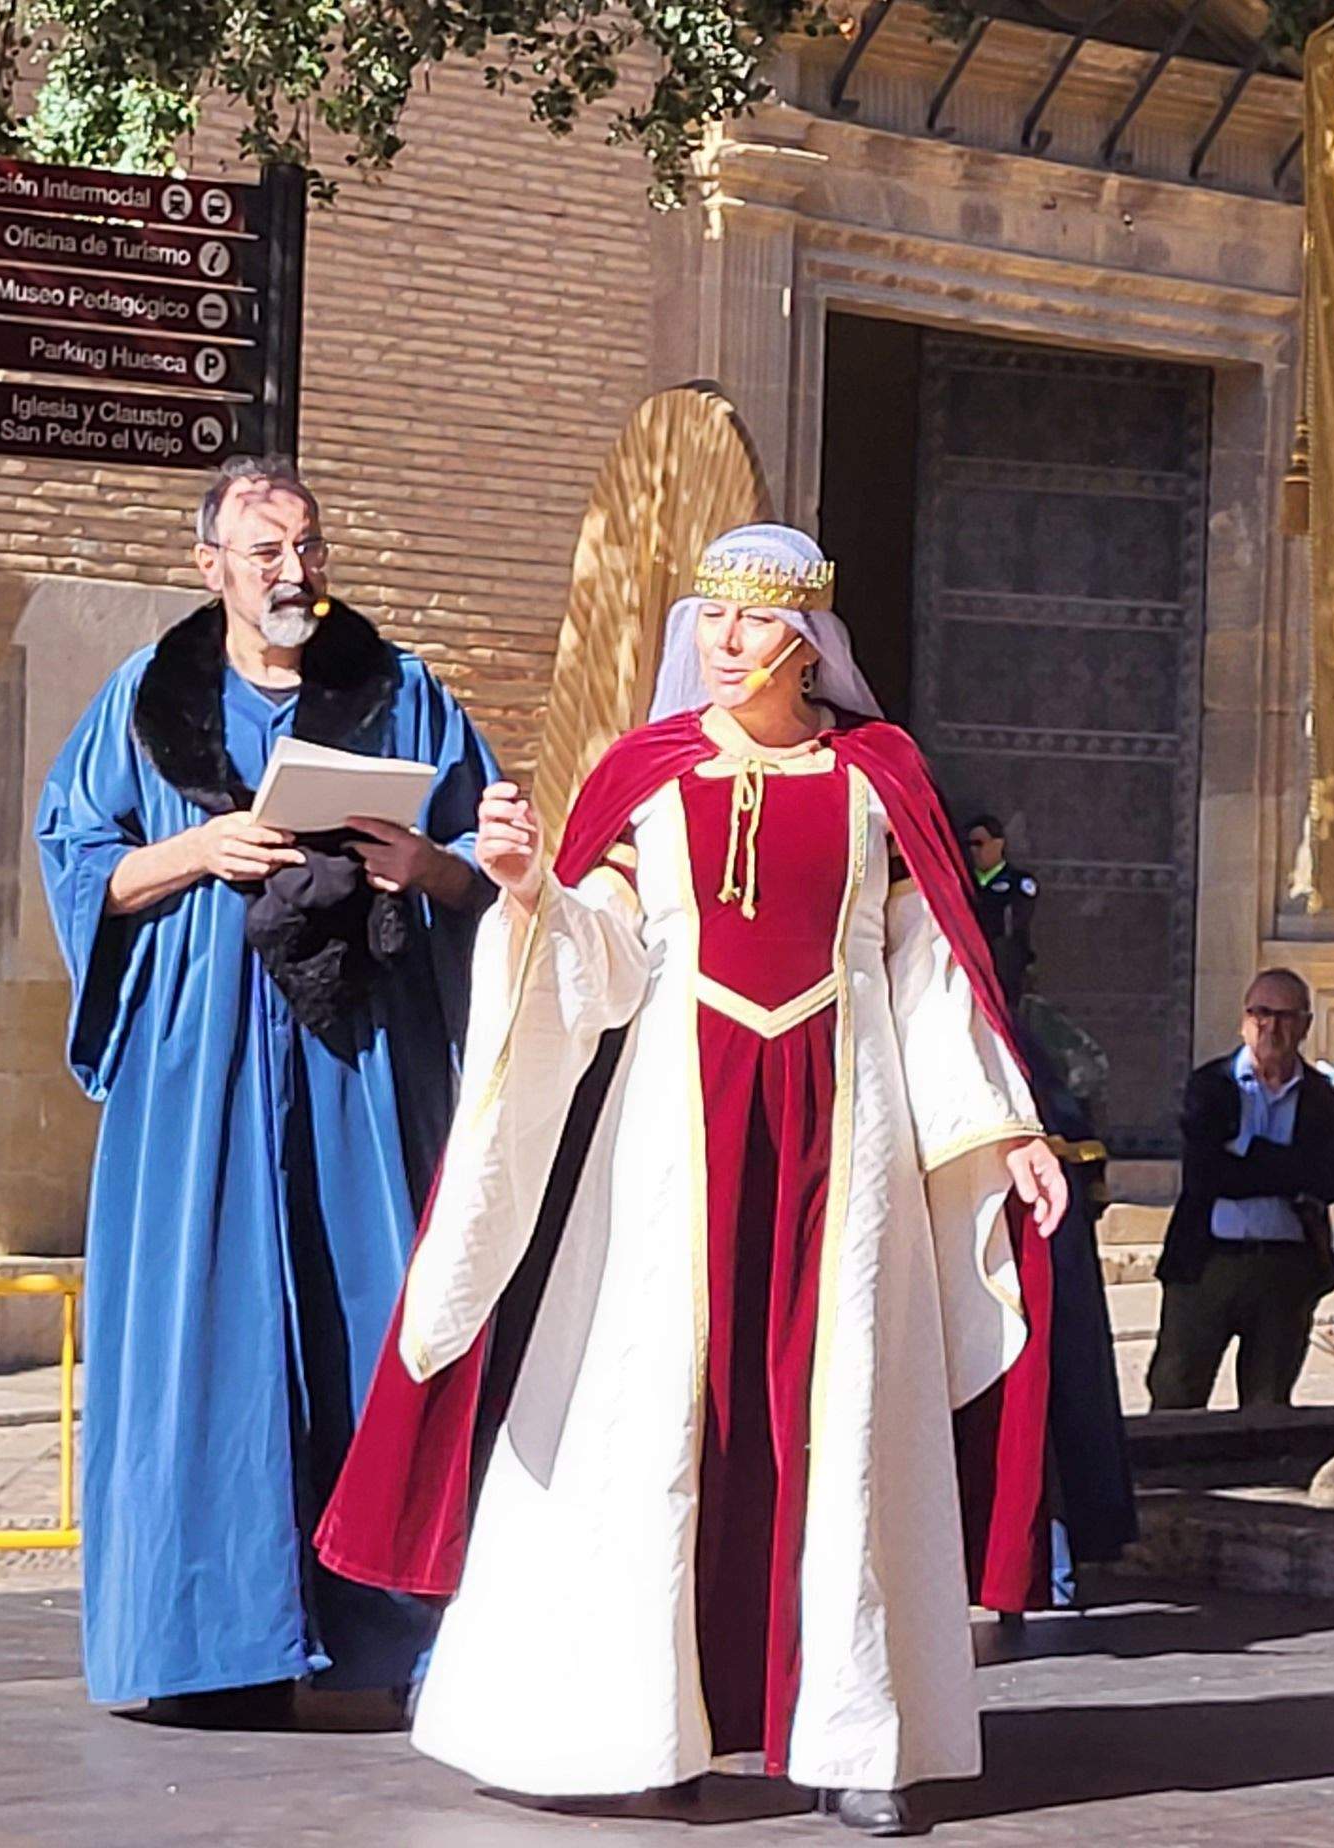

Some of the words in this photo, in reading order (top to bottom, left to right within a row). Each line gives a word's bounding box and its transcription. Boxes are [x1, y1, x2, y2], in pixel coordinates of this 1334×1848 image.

[42, 176, 152, 209] Intermodal
[4, 224, 77, 252] Oficina
[80, 233, 108, 256] de
[112, 236, 191, 267] Turismo
[68, 286, 190, 320] Pedagógico
[29, 336, 108, 370] Parking
[111, 346, 188, 374] Huesca
[11, 393, 79, 420] Iglesia
[82, 403, 95, 428] y
[98, 401, 184, 428] Claustro
[0, 419, 41, 442] San
[45, 422, 108, 448] Pedro
[111, 428, 129, 450] el
[133, 429, 184, 458] Viejo
